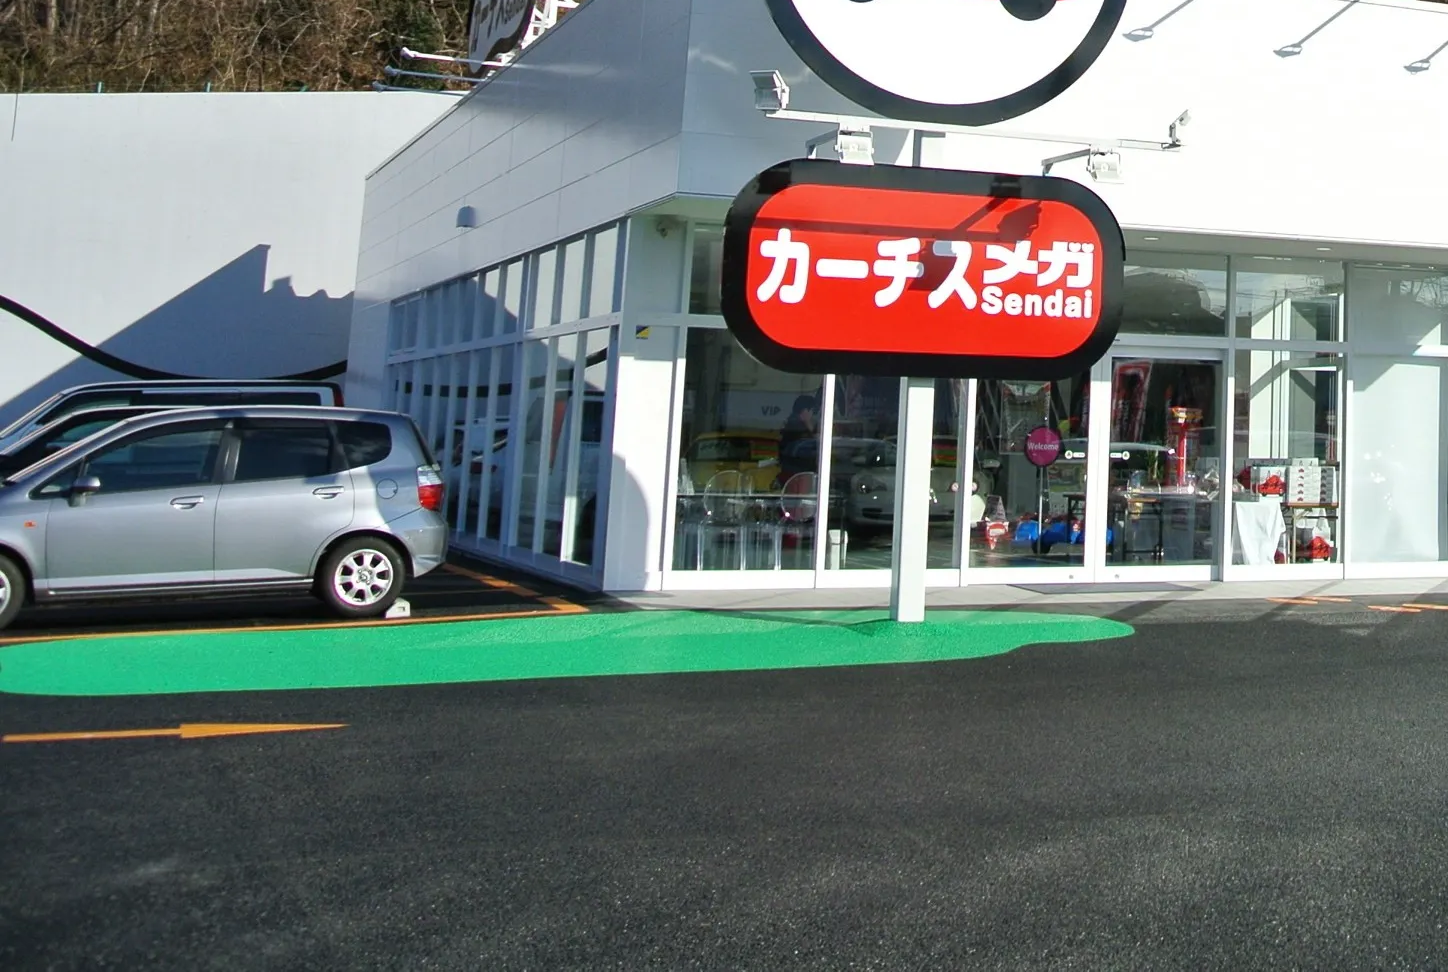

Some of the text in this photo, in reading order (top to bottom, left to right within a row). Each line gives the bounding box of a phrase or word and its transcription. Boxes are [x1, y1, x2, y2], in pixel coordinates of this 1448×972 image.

[756, 227, 1095, 310] カーチスメガ
[980, 285, 1094, 319] Sendai
[761, 405, 781, 416] VIP
[1028, 441, 1059, 451] Welcome
